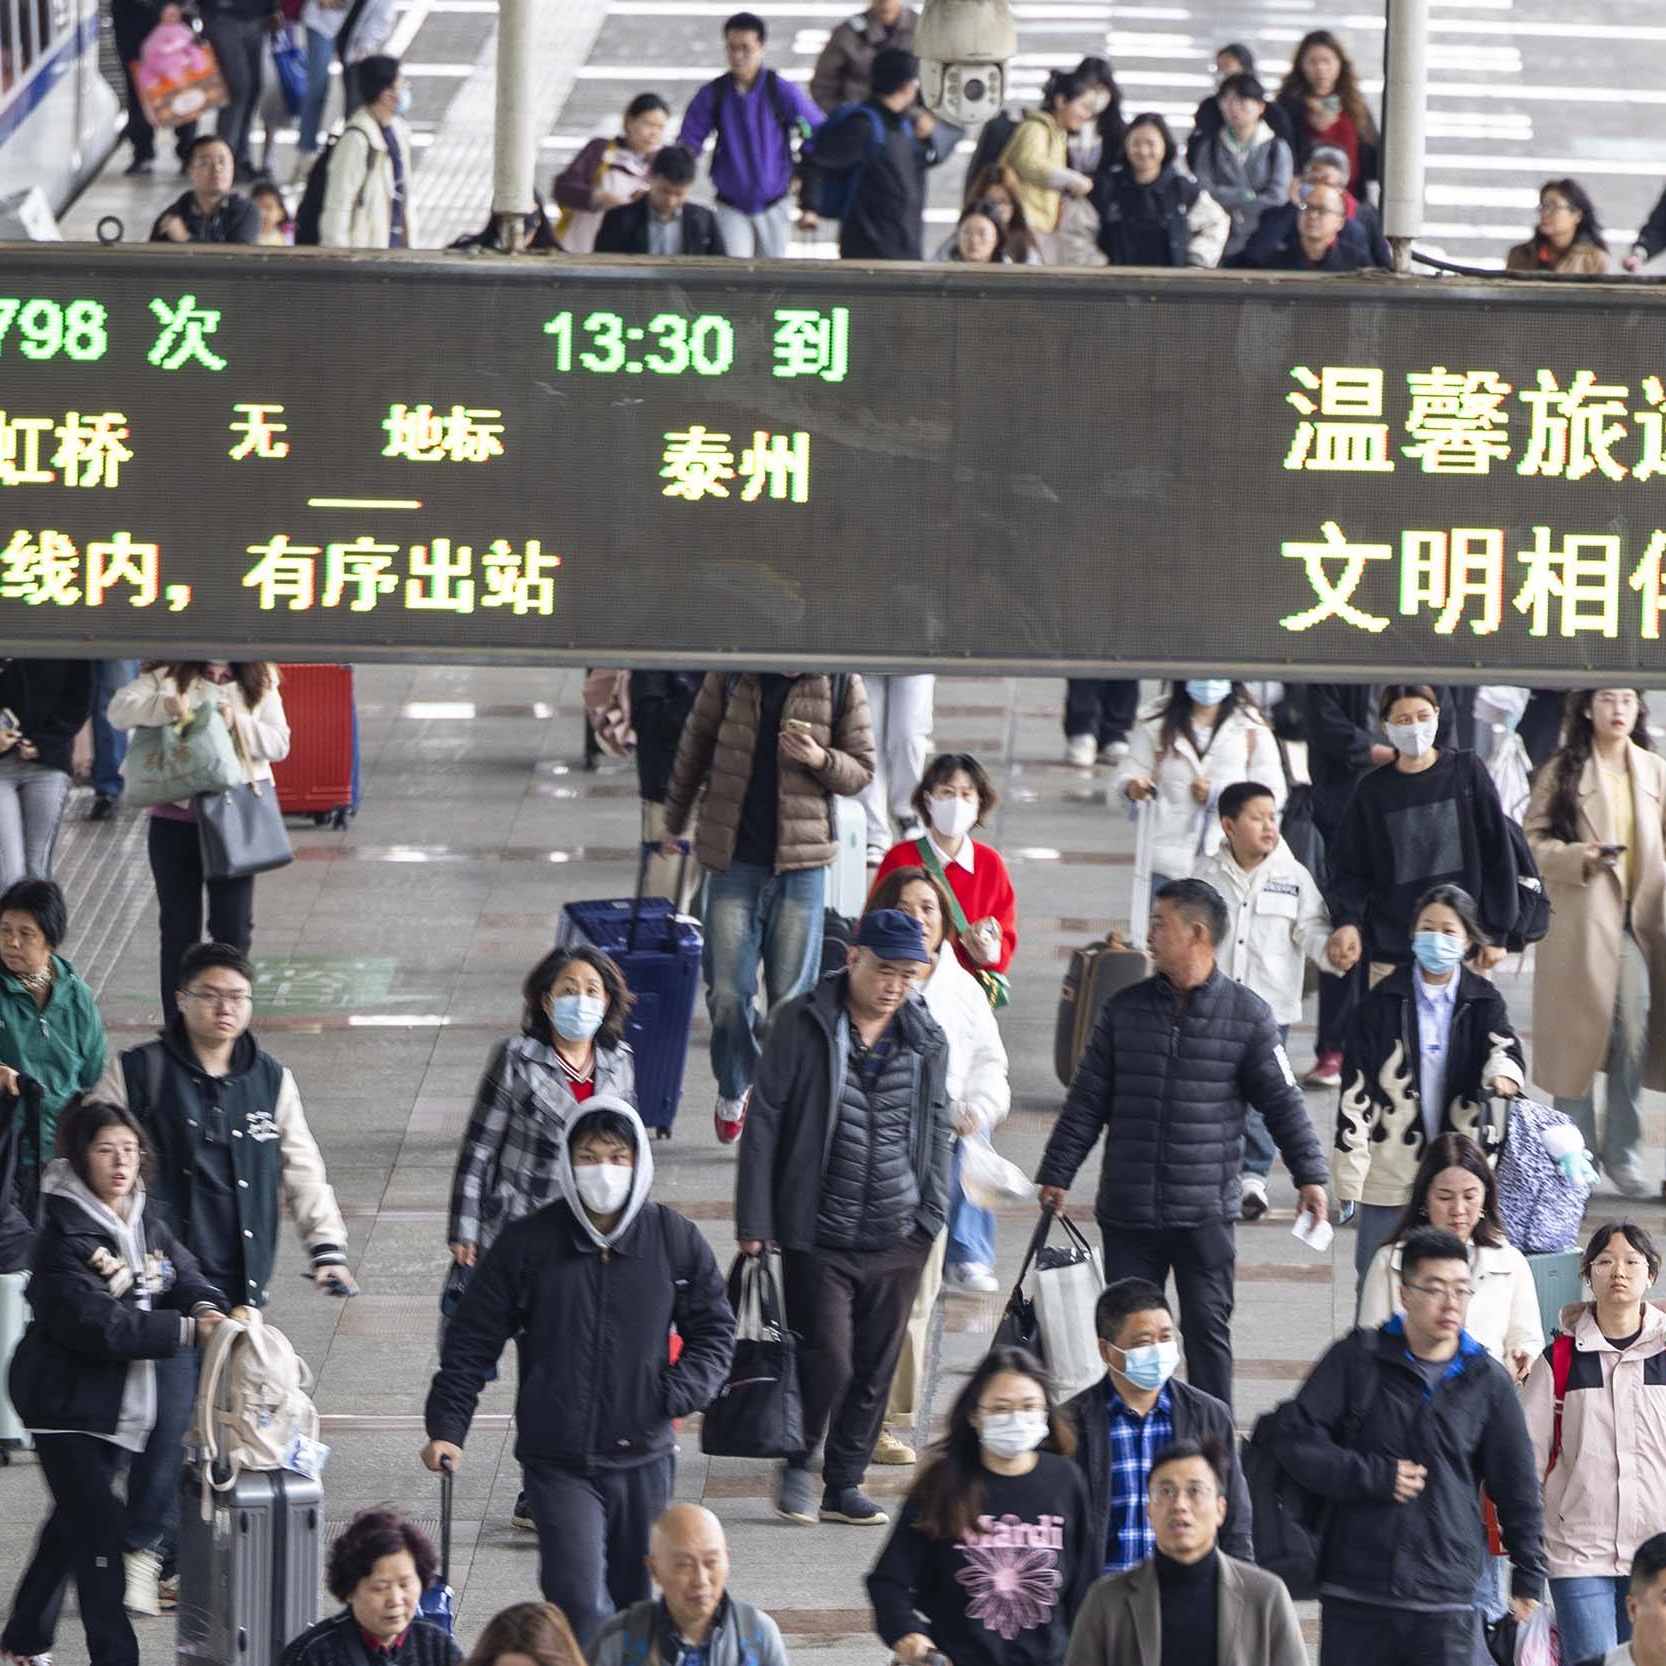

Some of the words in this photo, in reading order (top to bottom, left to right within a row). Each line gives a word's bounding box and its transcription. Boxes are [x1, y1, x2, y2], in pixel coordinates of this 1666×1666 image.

[147, 294, 228, 371] 次
[543, 311, 734, 376] 13:30
[772, 307, 850, 382] 到
[228, 403, 290, 461] 无
[381, 403, 505, 463] 地标
[658, 425, 810, 503] 泰州
